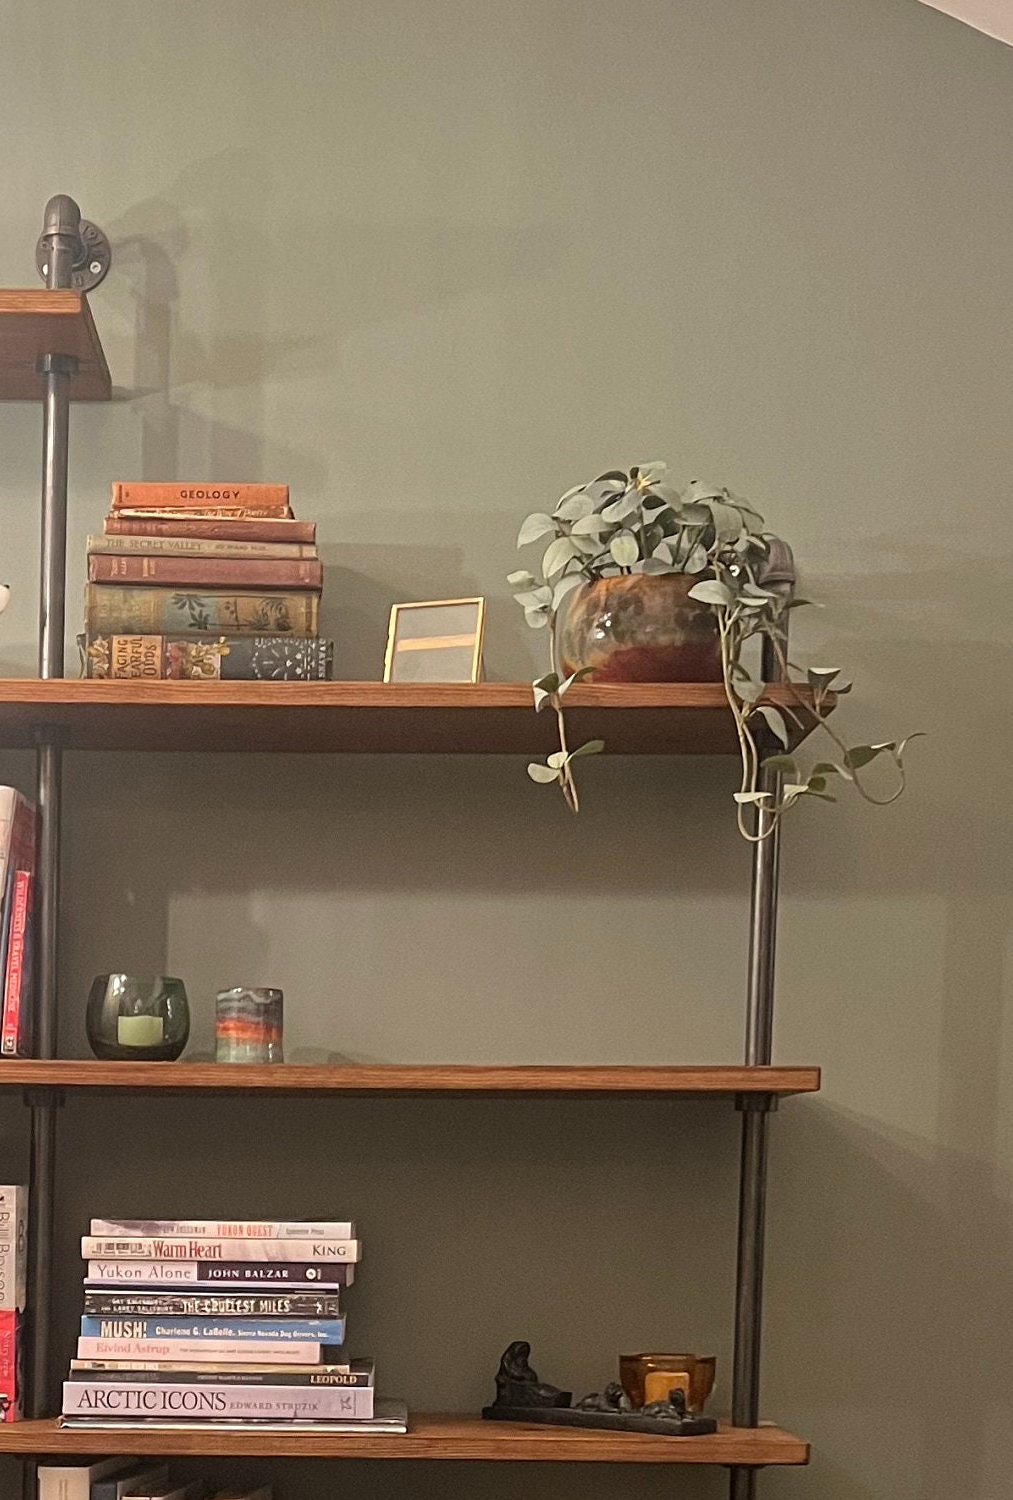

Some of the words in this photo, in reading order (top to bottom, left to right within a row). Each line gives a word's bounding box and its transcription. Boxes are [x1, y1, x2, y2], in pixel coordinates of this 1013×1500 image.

[180, 490, 240, 499] GEOLOGY
[107, 539, 123, 548] THE
[128, 540, 165, 550] SECRET
[168, 540, 202, 551] VALLEY
[115, 639, 129, 679] FACING
[143, 644, 158, 676] ODDS
[217, 1224, 244, 1236] YUKON
[246, 1225, 273, 1237] QUEST
[152, 1240, 187, 1258] Warm
[189, 1241, 223, 1259] Heart
[312, 1244, 347, 1257] KING
[97, 1264, 142, 1278] Yukon
[149, 1265, 191, 1279] Alone
[208, 1269, 240, 1279] JOHN
[244, 1269, 289, 1279] BALZAR
[183, 1299, 199, 1313] THE
[259, 1299, 291, 1313] MILES
[100, 1321, 147, 1339] MUSH!
[155, 1326, 191, 1336] Charlene
[96, 1342, 131, 1353] Eivind
[133, 1342, 170, 1355] Astrup
[310, 1375, 357, 1384] LEOPOLD
[77, 1389, 157, 1409] ARCTIC
[161, 1390, 227, 1411] ICONS
[229, 1402, 273, 1410] EDWARD
[275, 1402, 319, 1411] STRUZIK
